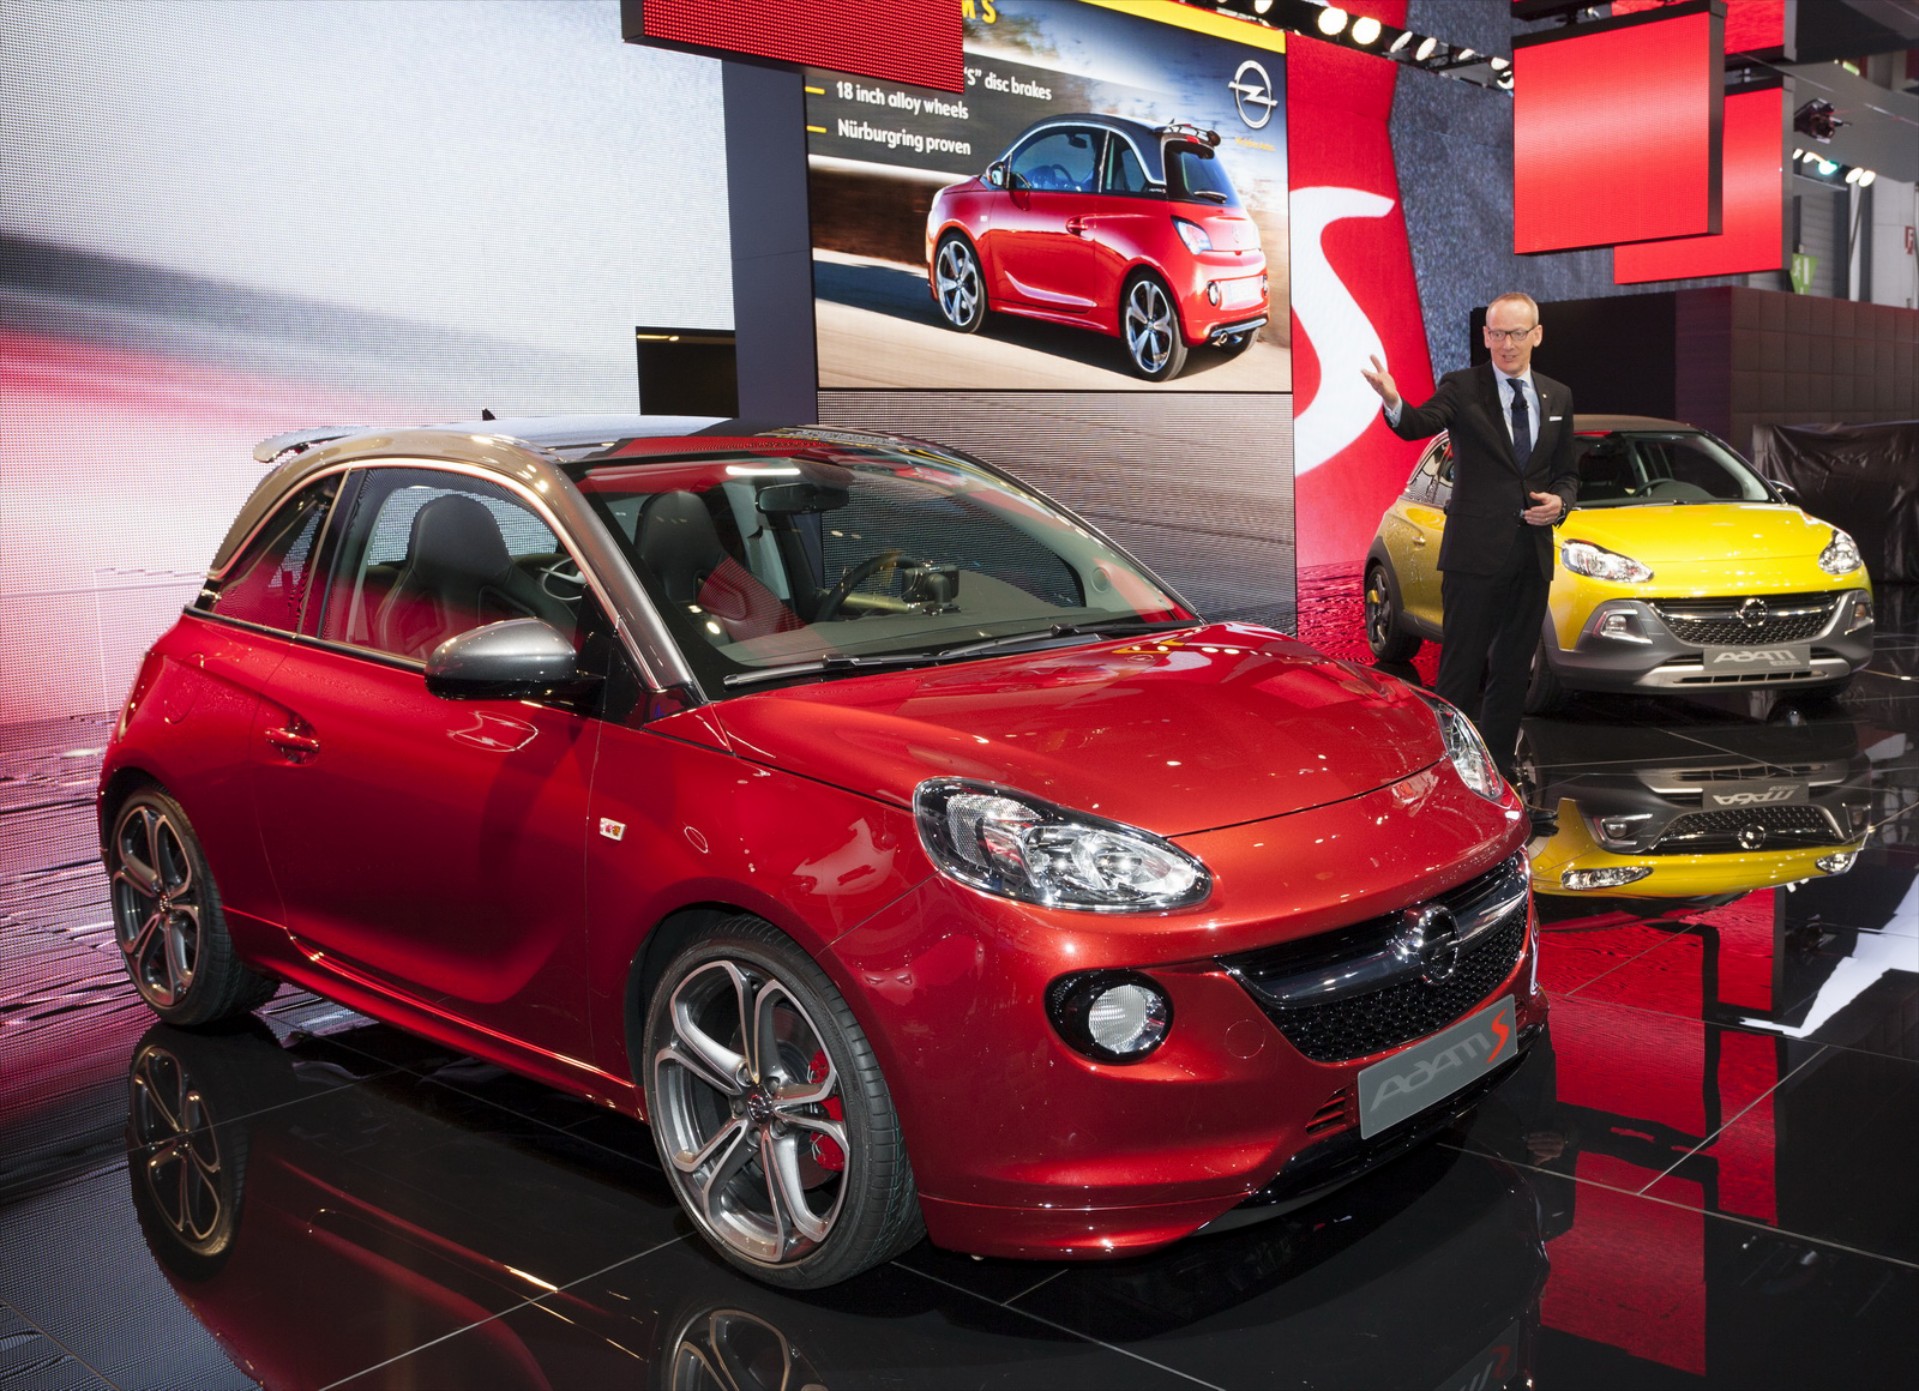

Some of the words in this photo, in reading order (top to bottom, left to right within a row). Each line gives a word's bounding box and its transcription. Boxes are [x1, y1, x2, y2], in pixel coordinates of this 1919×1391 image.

[836, 81, 853, 100] 18
[856, 85, 885, 106] inch
[887, 92, 921, 115] alloy
[923, 99, 969, 120] wheels
[985, 72, 1009, 93] disc
[1011, 77, 1053, 100] brakes
[837, 118, 923, 152] Nürburgring
[925, 139, 971, 155] proven
